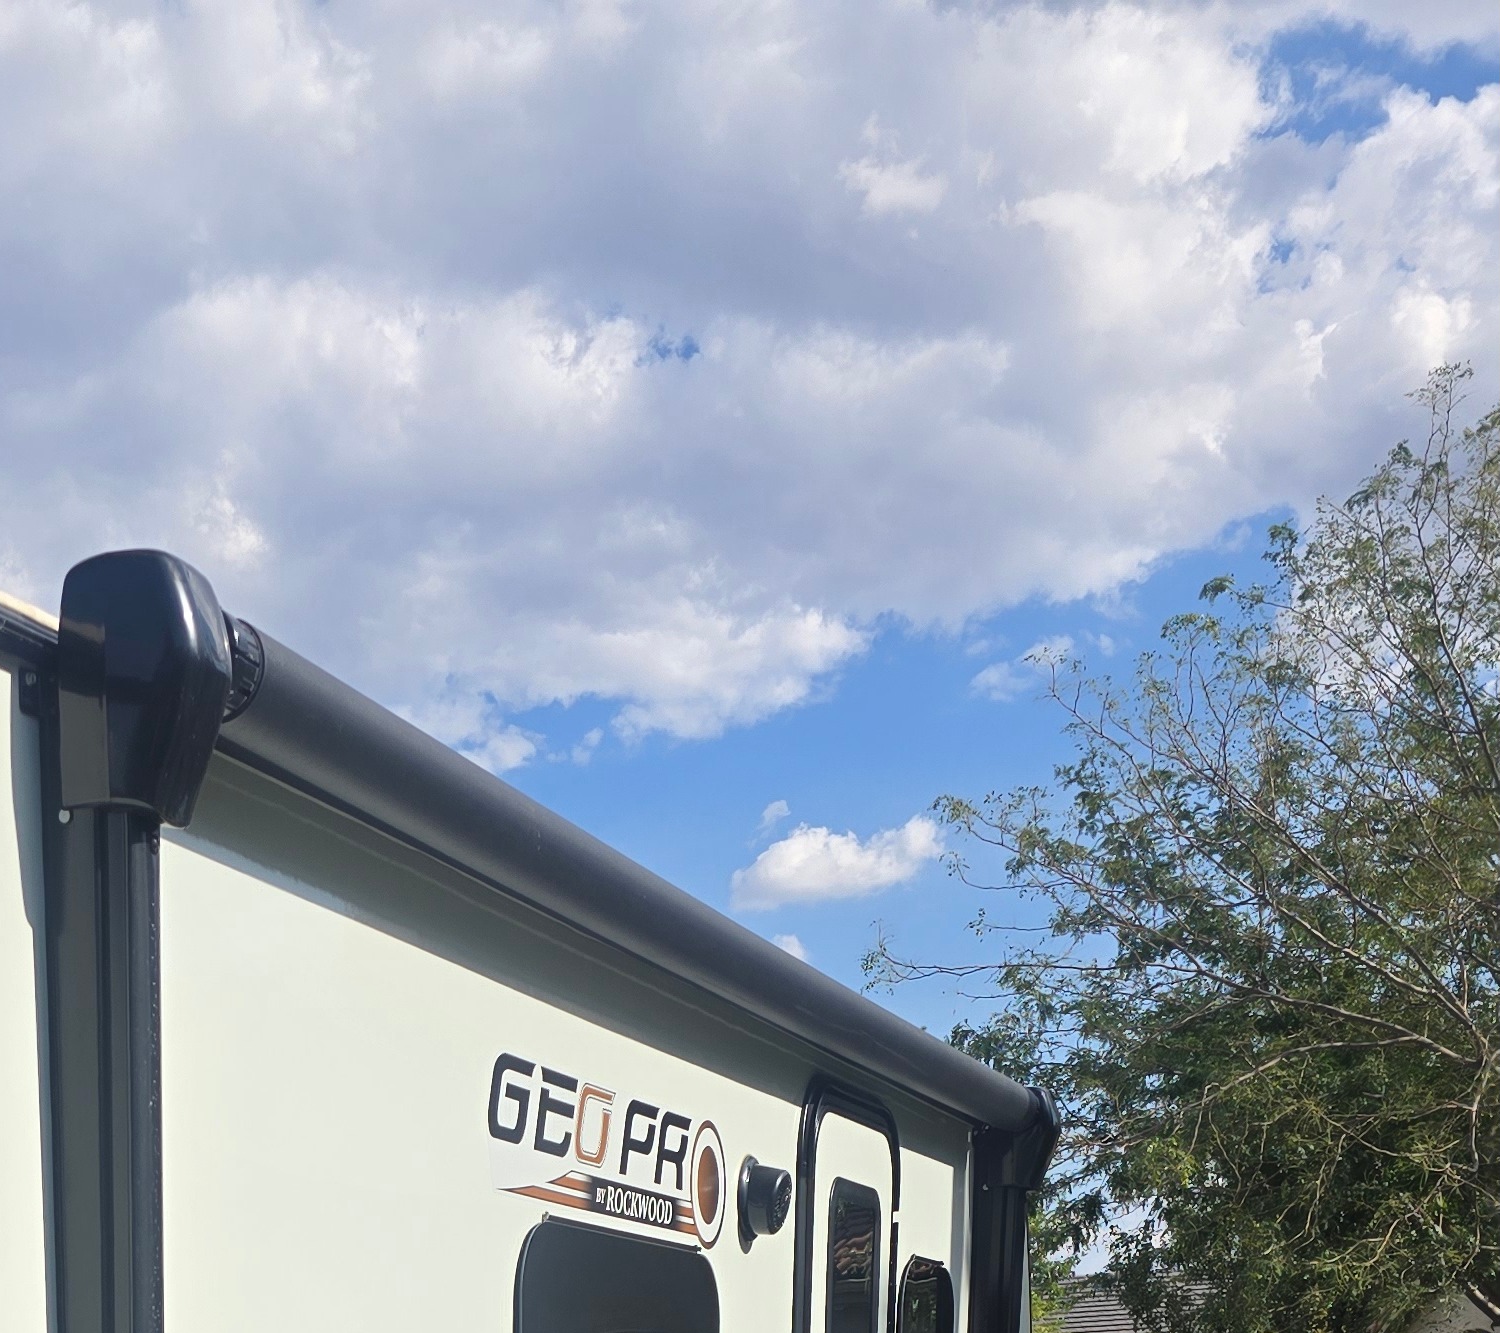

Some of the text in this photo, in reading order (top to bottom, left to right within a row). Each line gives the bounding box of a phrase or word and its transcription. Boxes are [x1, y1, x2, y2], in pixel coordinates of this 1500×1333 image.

[488, 1053, 727, 1250] GEO PRO
[595, 1185, 673, 1225] BY ROCKWOOD
